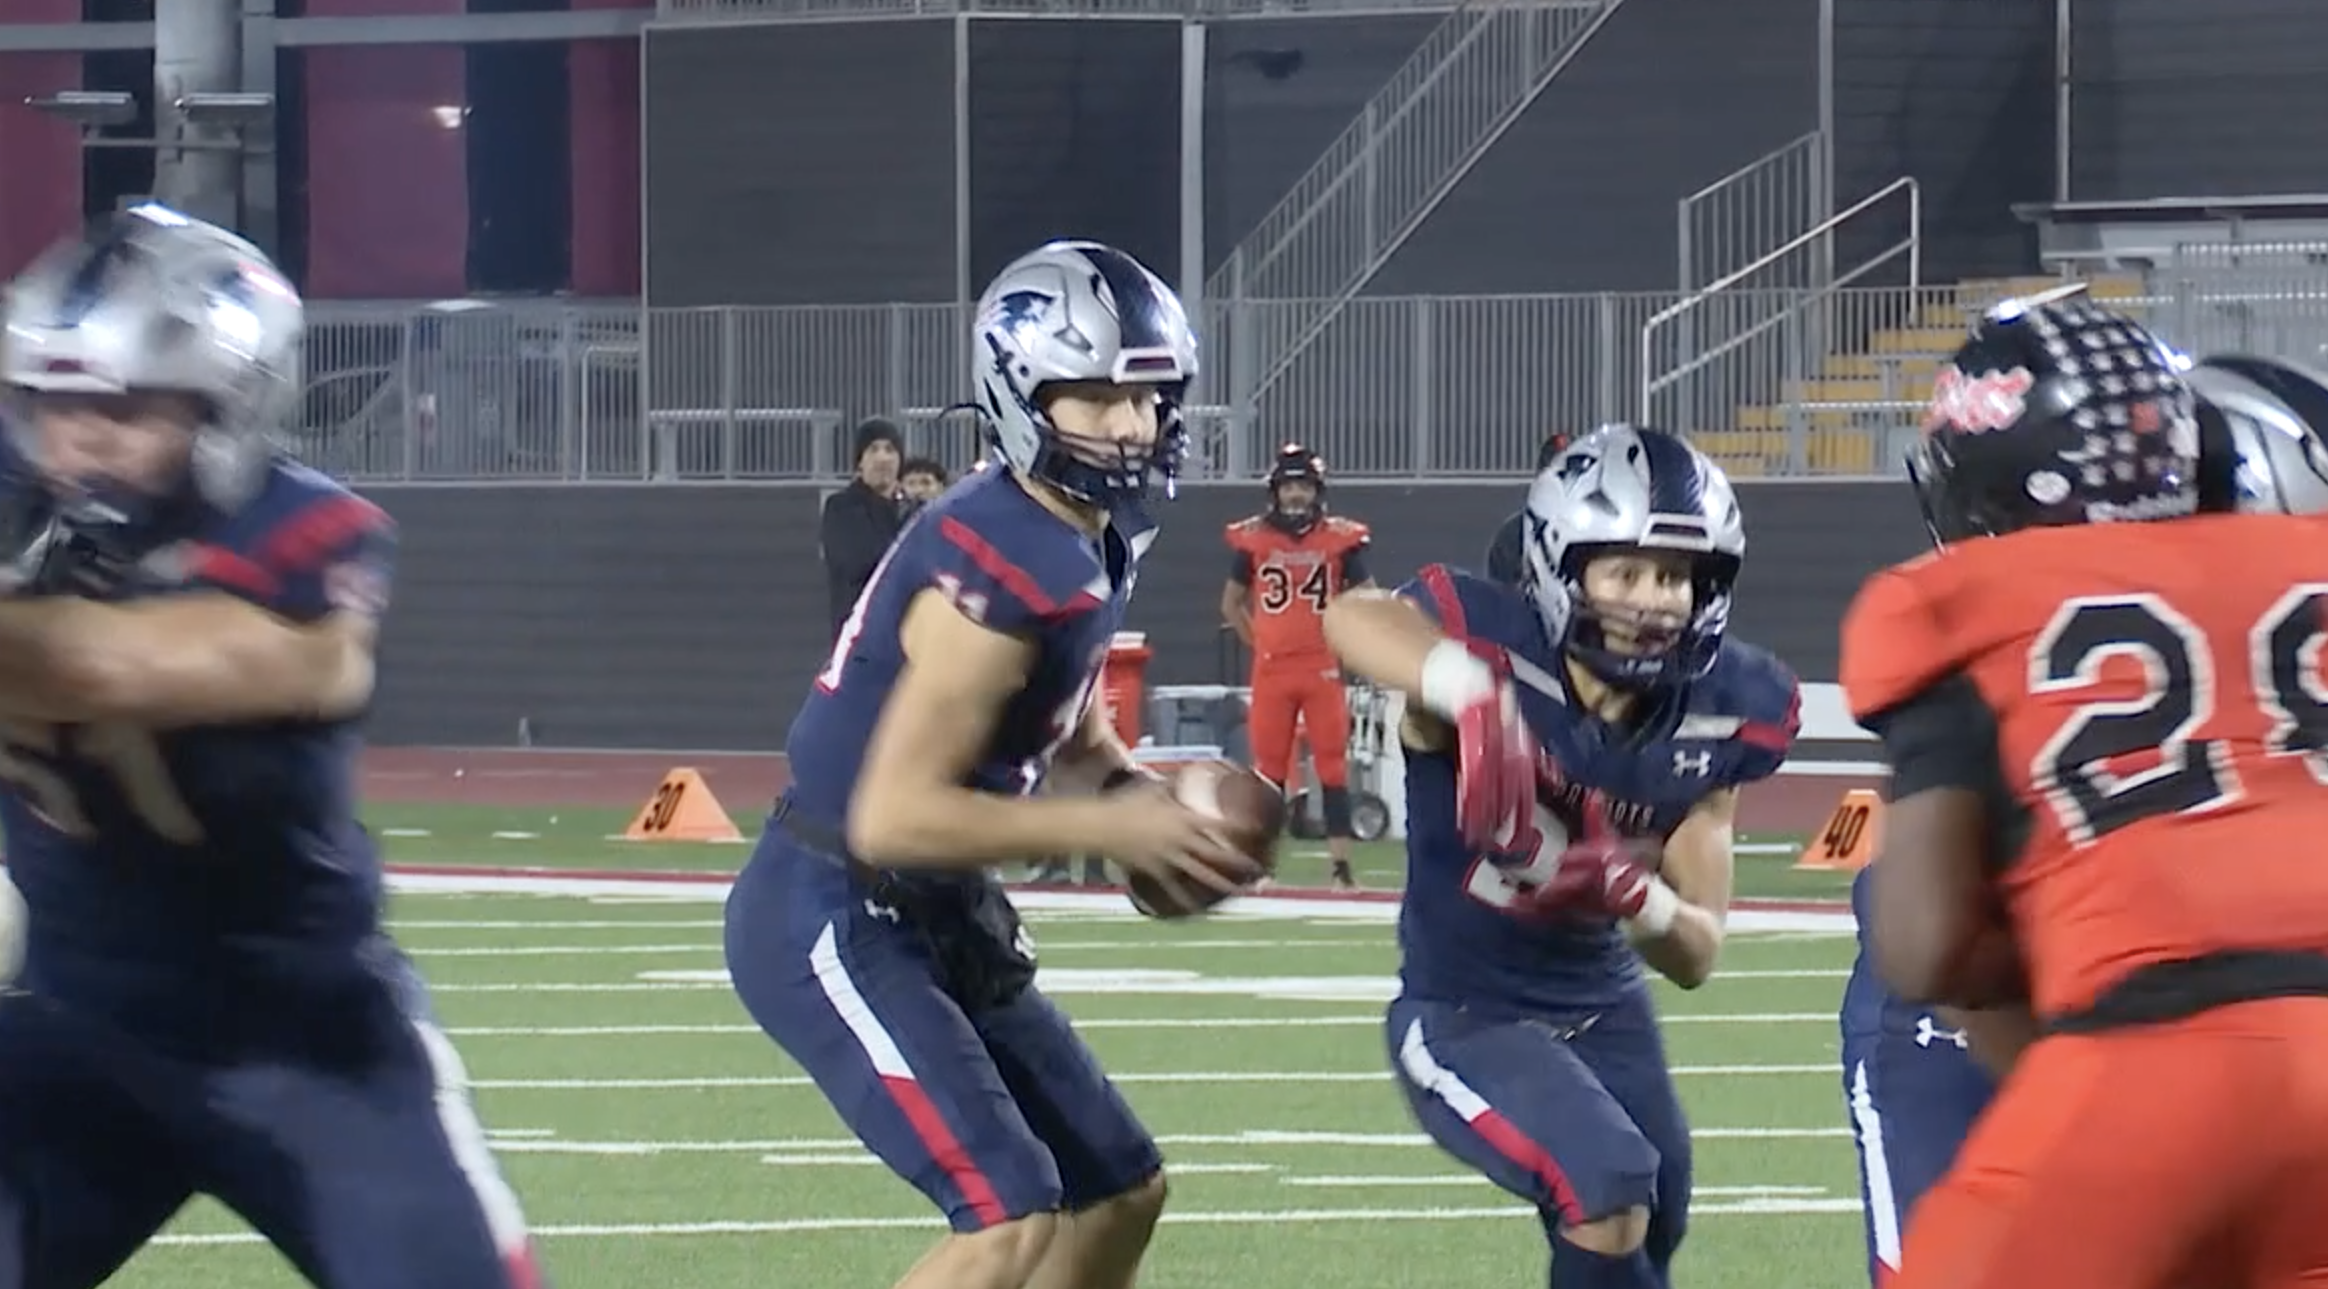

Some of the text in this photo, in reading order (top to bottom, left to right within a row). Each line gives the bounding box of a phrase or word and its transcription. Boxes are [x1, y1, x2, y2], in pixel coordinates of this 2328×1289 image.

[1259, 563, 1331, 615] 34
[643, 781, 685, 832] 30
[1824, 804, 1870, 859] 40
